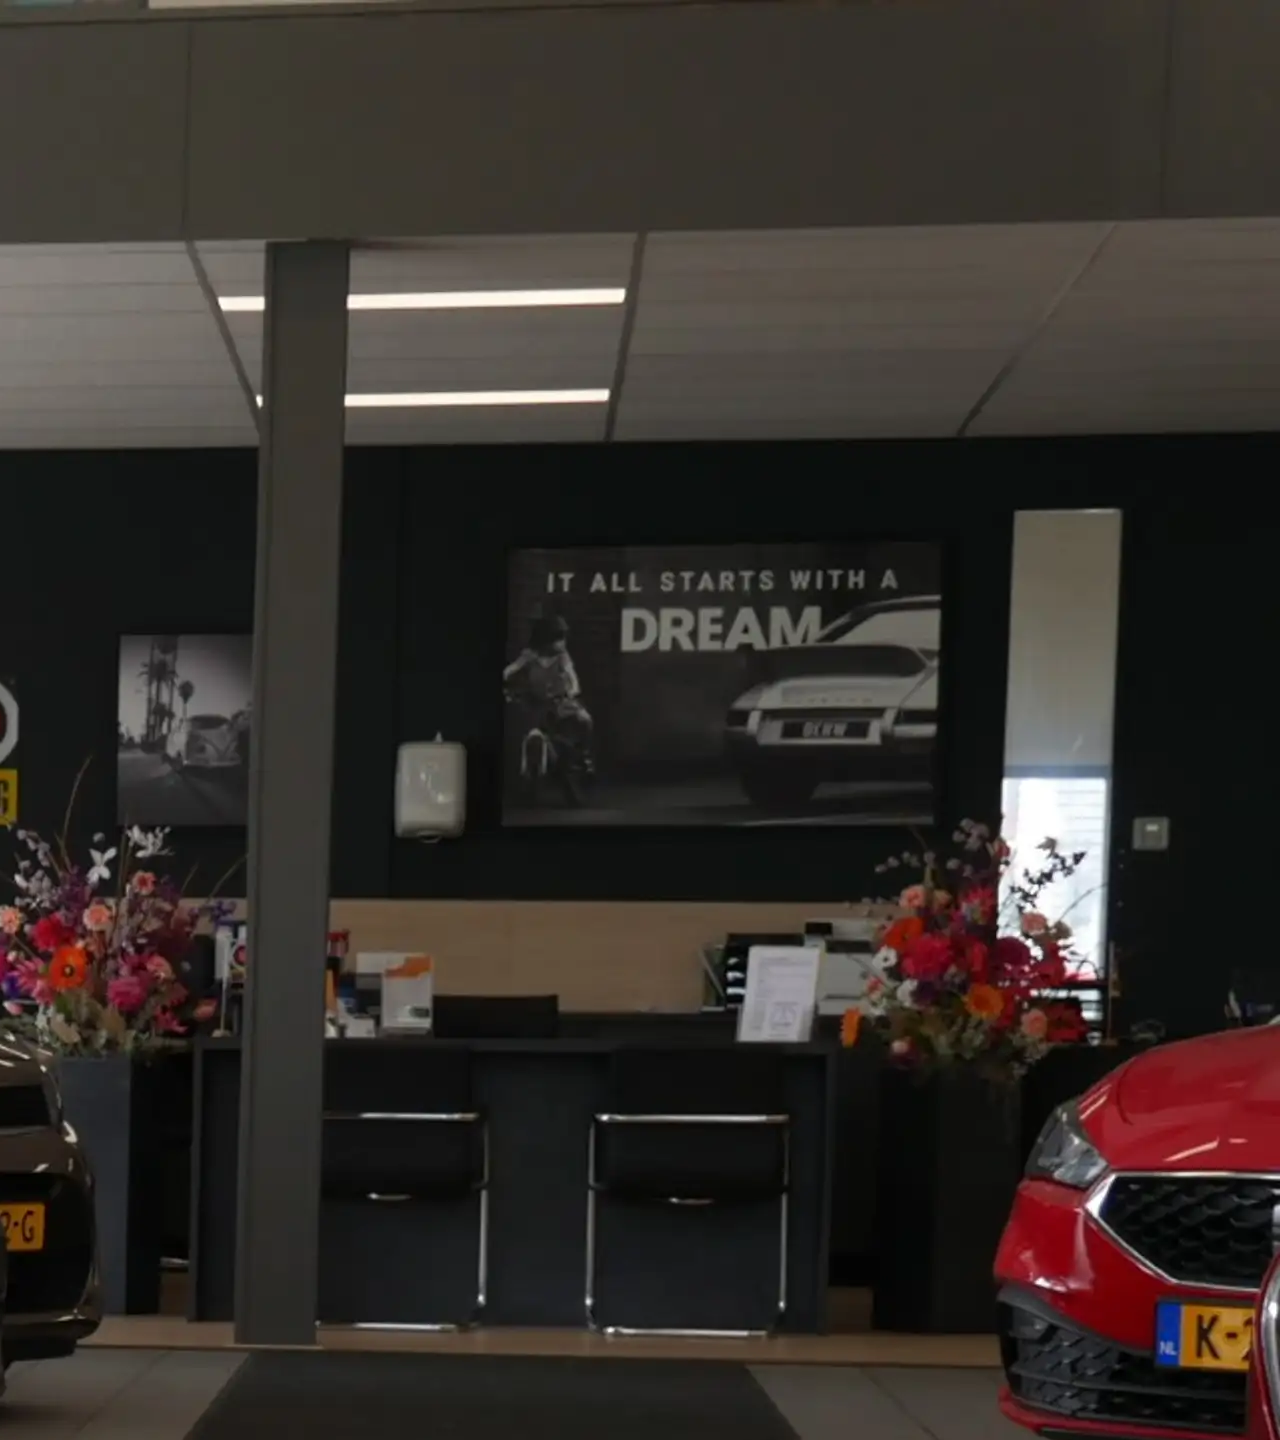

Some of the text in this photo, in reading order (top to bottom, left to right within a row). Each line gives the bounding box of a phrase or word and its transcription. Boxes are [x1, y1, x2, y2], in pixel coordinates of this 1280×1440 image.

[547, 568, 899, 593] IT ALL STARTS WITH A
[620, 605, 822, 653] DREAM
[1159, 1340, 1178, 1356] NL
